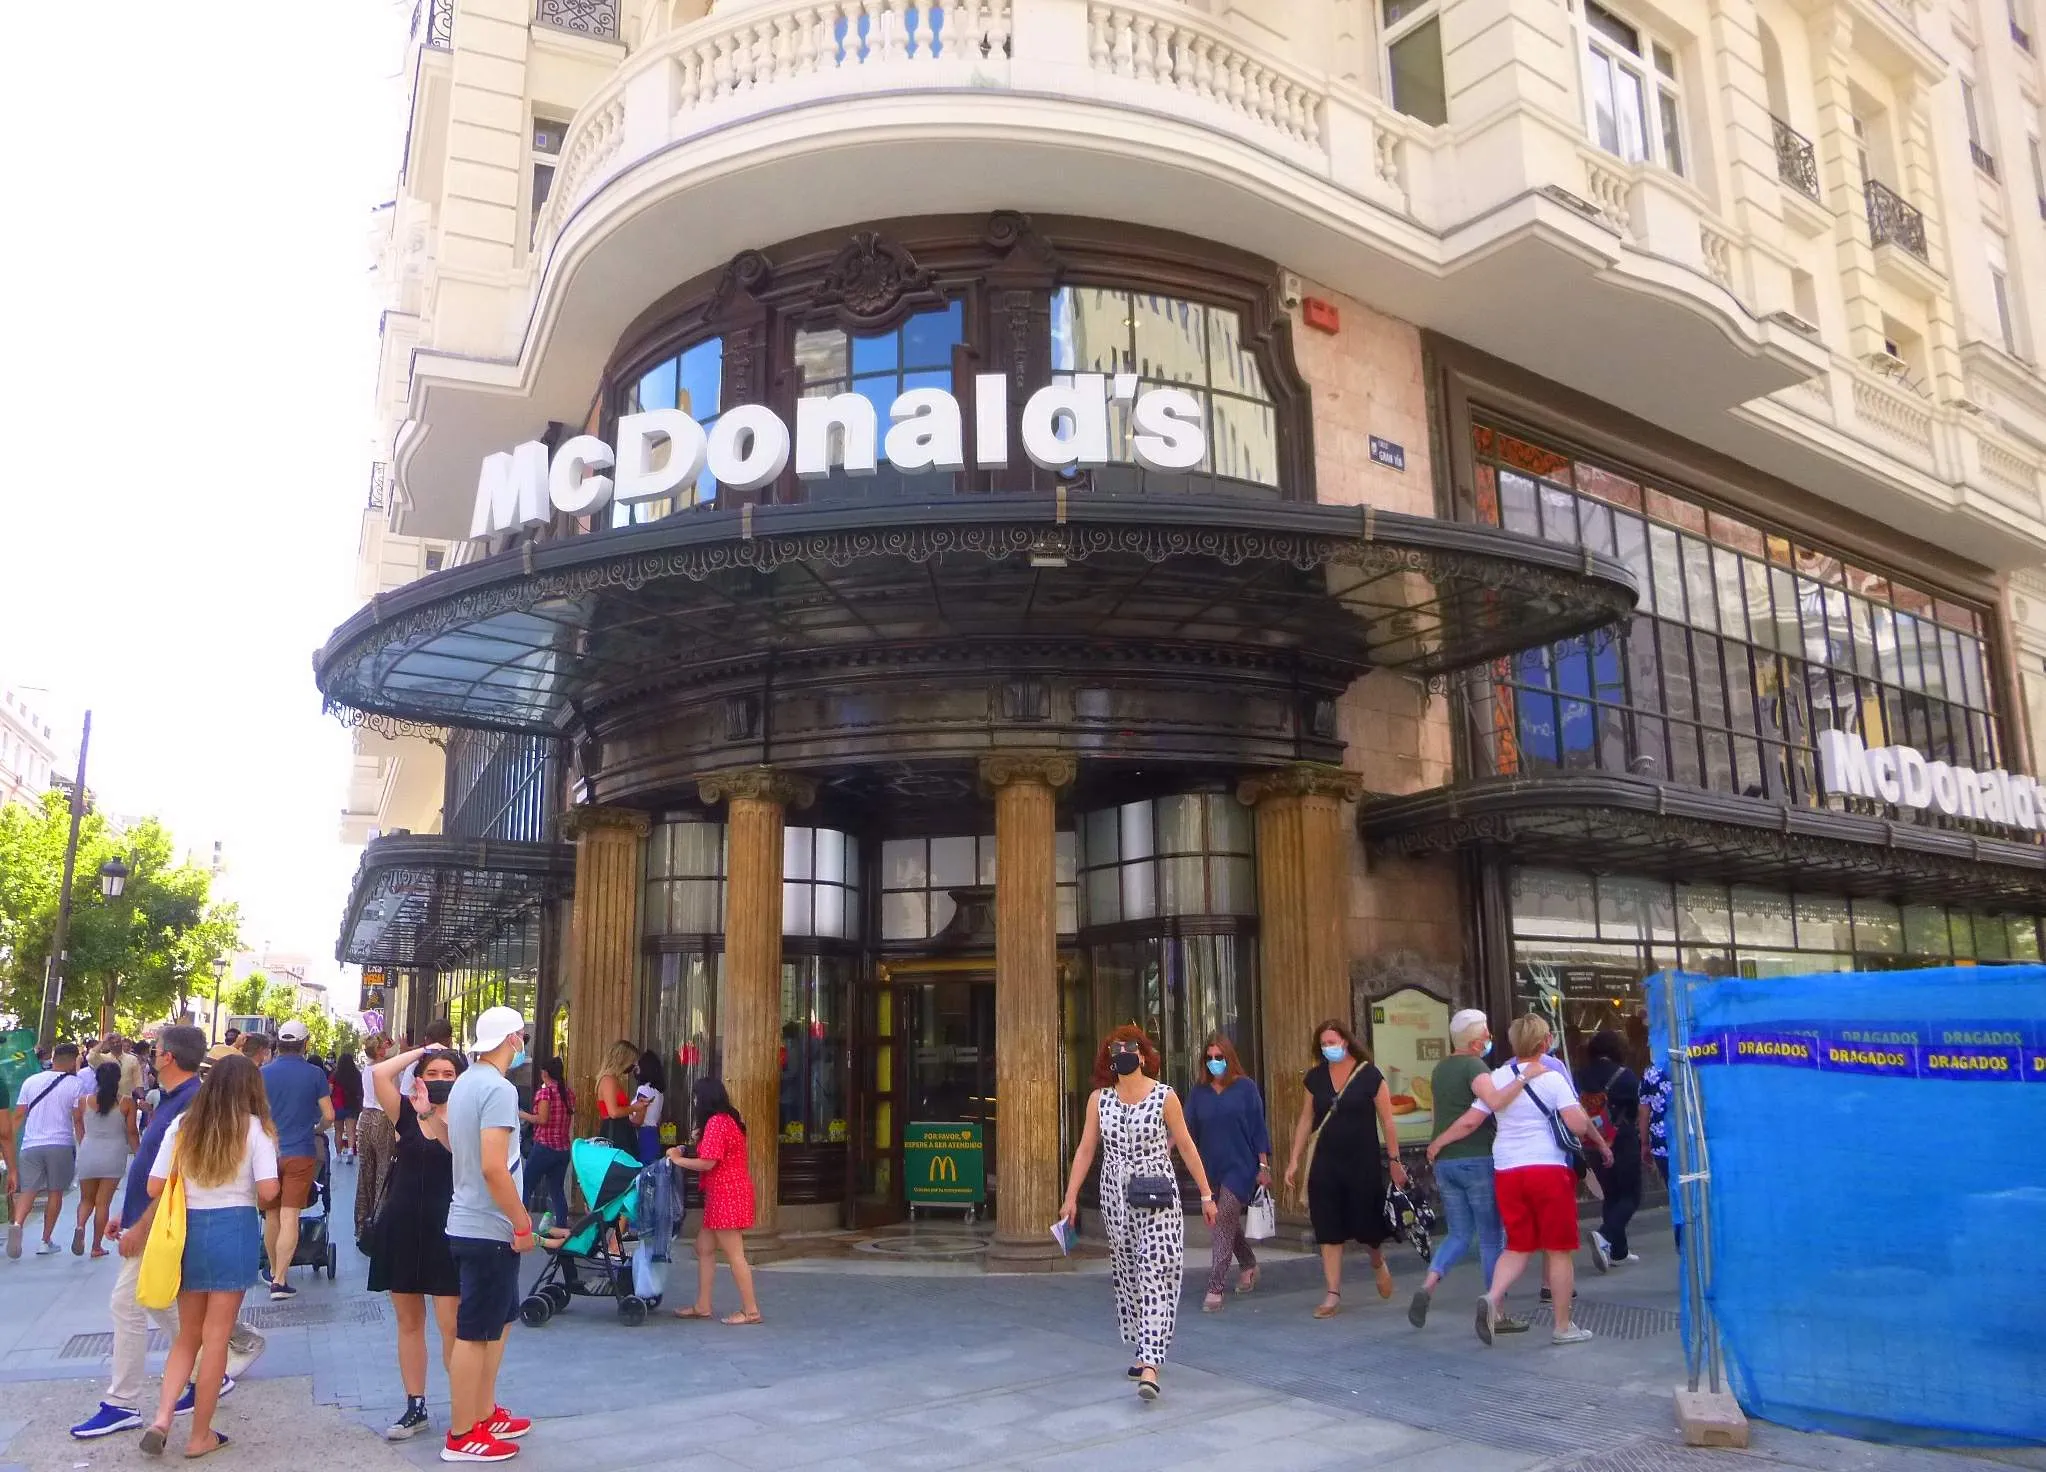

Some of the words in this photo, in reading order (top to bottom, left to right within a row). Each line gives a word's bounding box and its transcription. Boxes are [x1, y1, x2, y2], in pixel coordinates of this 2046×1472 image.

[469, 372, 1207, 541] McDonald's
[1842, 1031, 1919, 1045] DRAGADOS
[1943, 1031, 2024, 1046] DRAGADOS
[1738, 1041, 1809, 1058] DRAGADOS
[1829, 1049, 1905, 1067] DRAGADOS
[1928, 1055, 2009, 1072] DRAGADOS
